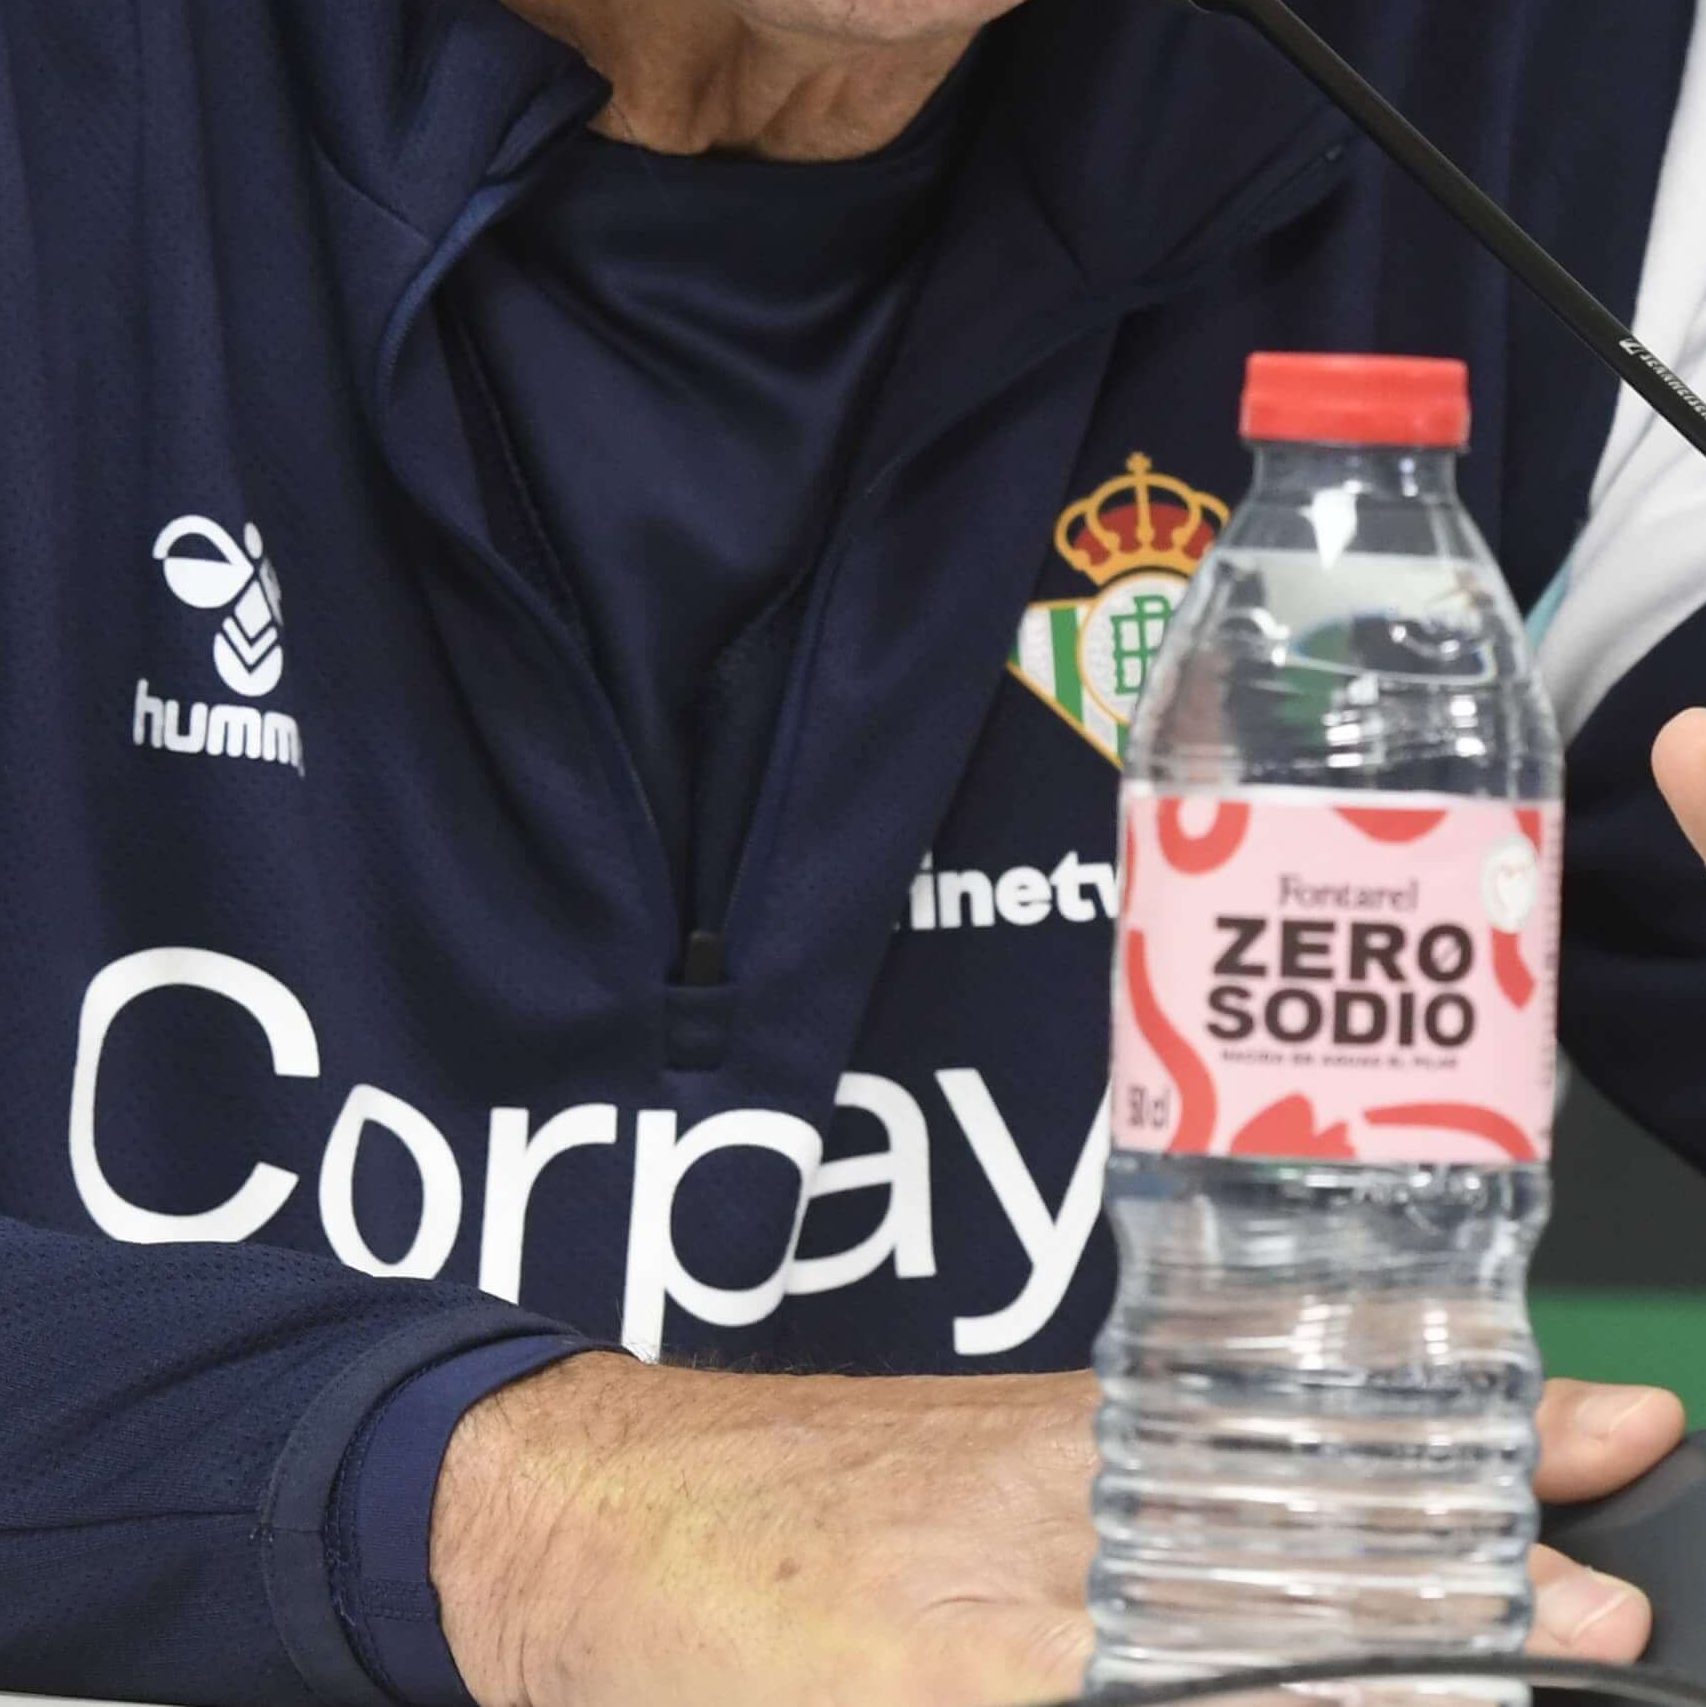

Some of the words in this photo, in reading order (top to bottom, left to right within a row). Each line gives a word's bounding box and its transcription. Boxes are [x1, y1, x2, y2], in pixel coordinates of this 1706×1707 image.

[1213, 915, 1475, 984] ZERO
[1206, 984, 1476, 1049] SODIO
[69, 944, 1115, 1362] Corpay
